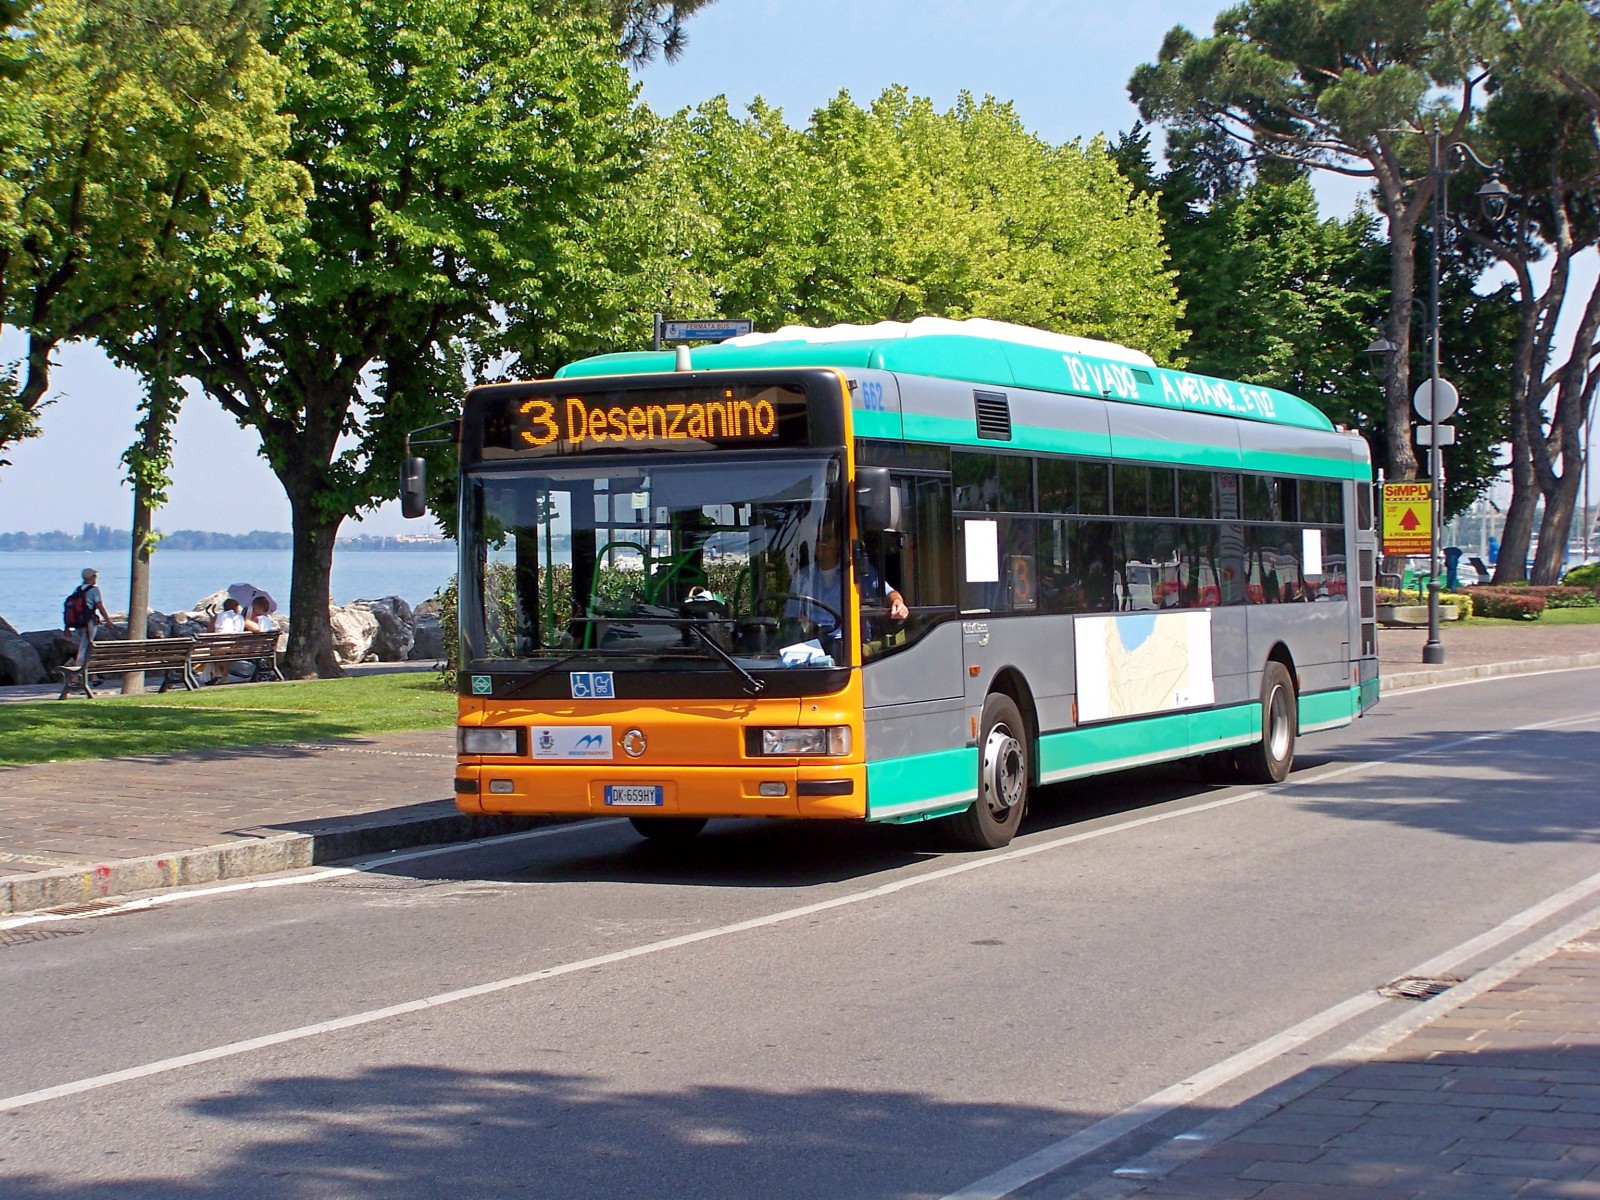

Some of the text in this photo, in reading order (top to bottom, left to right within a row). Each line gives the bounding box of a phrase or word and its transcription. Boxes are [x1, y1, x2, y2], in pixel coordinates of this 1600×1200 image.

[862, 381, 884, 411] 662
[1086, 362, 1139, 398] VADO
[1160, 373, 1179, 403] A
[1240, 386, 1254, 410] E
[520, 390, 776, 445] 3 Desenzanino
[1012, 559, 1031, 602] 3
